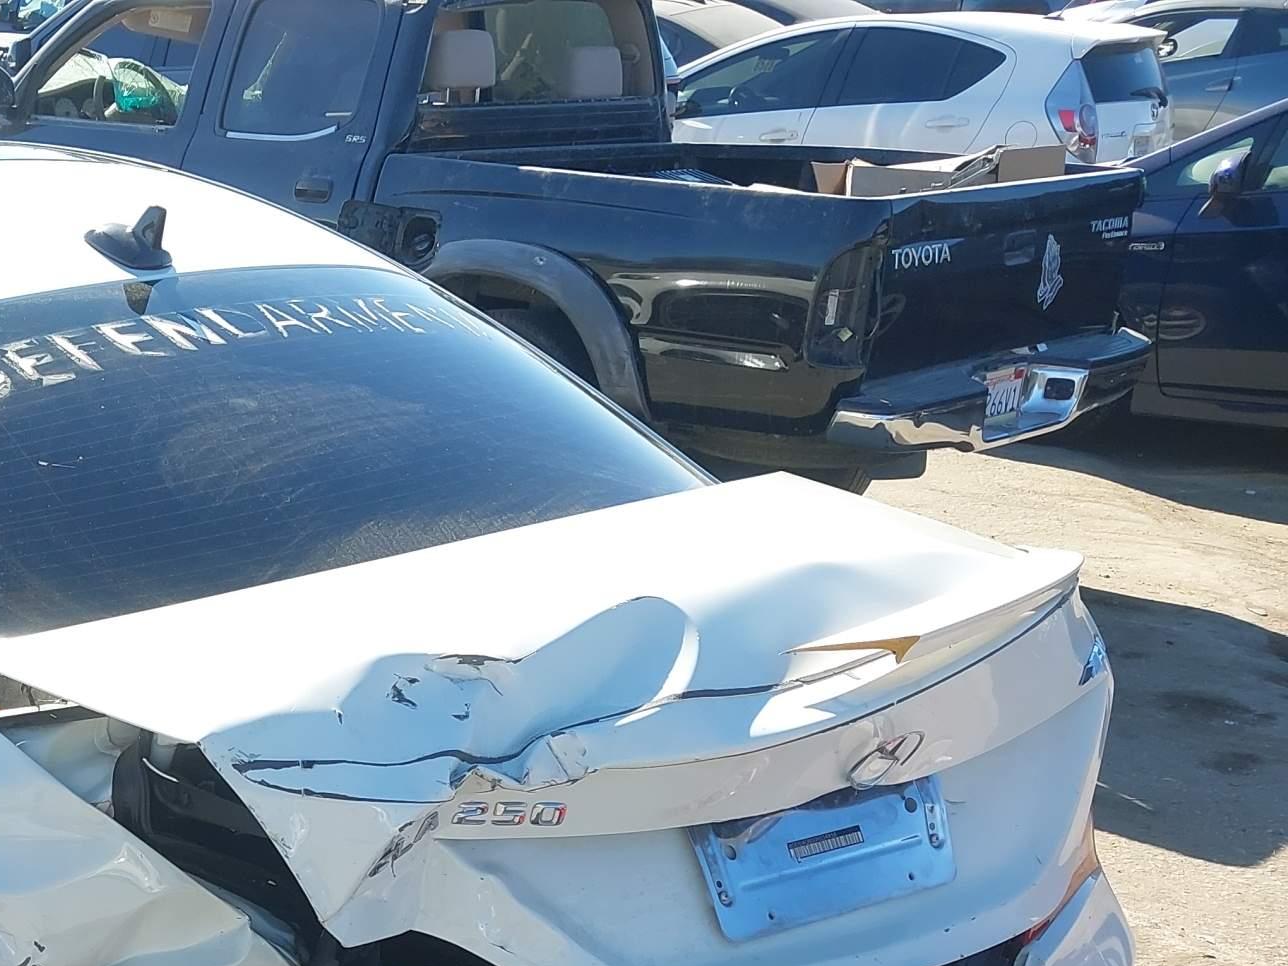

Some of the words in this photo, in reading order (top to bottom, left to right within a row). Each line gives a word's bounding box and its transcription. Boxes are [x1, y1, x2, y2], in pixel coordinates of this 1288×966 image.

[1090, 216, 1129, 232] TACOMA
[891, 242, 951, 270] TOYOTA
[450, 801, 568, 826] 250
